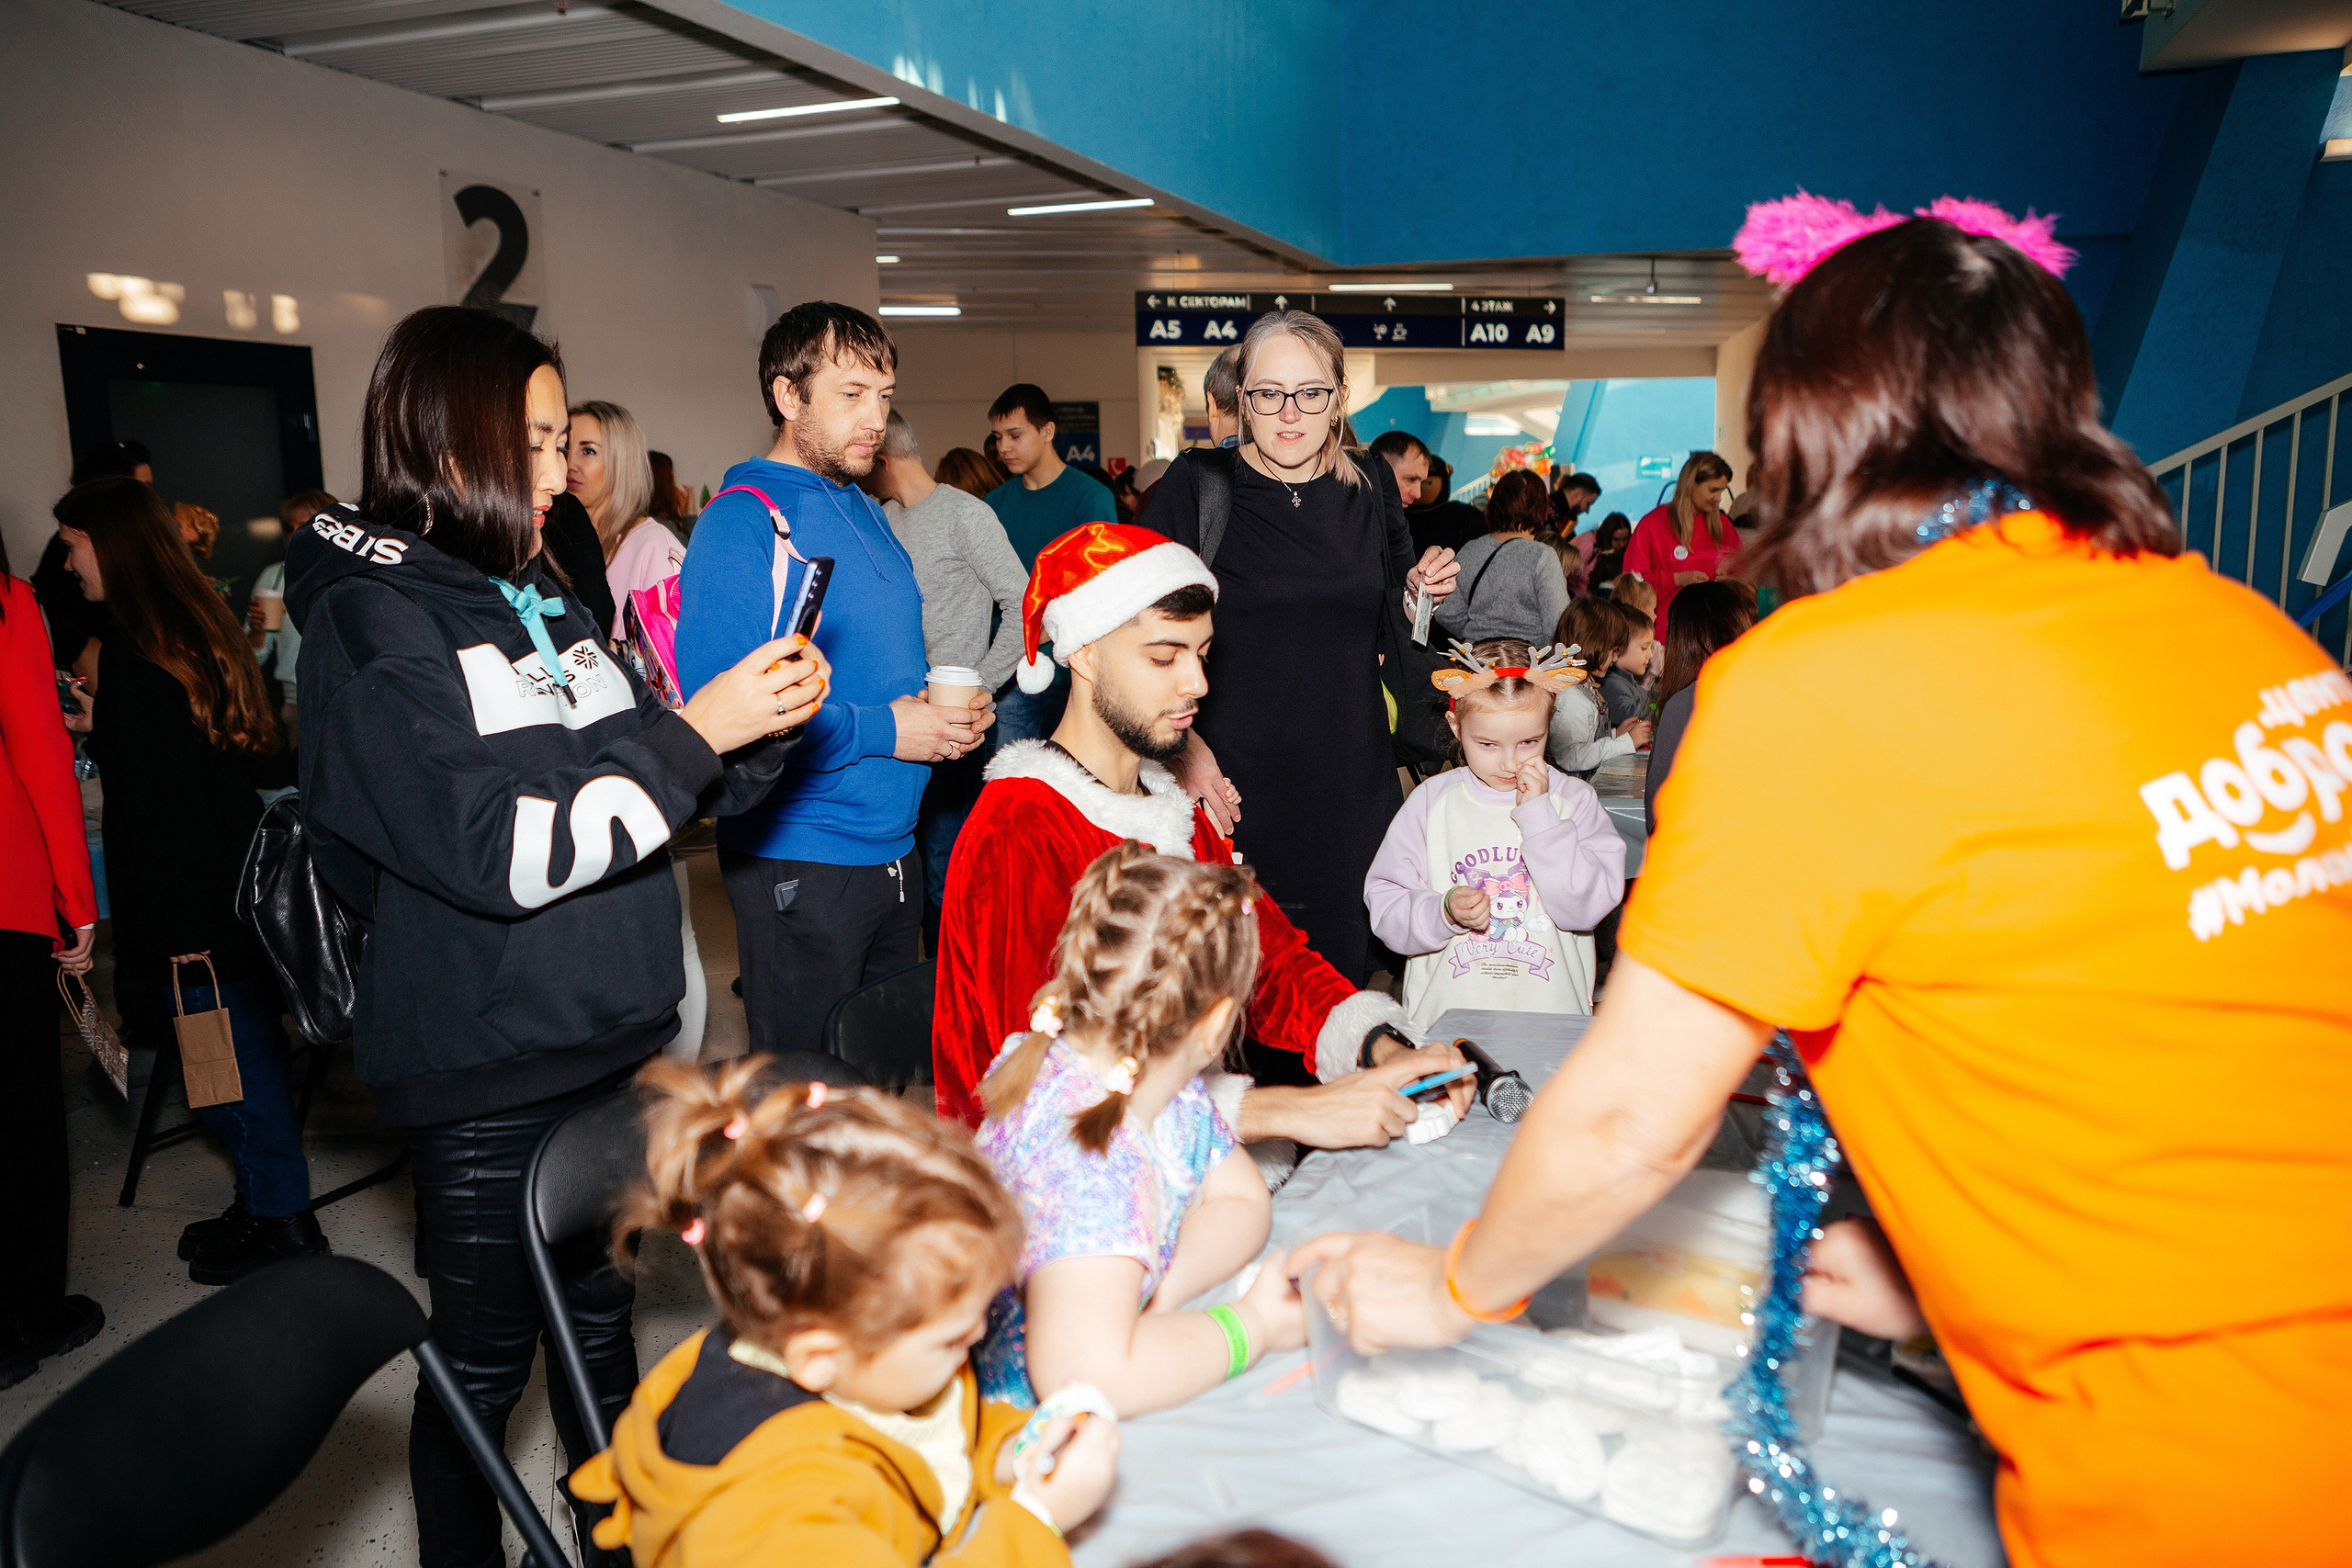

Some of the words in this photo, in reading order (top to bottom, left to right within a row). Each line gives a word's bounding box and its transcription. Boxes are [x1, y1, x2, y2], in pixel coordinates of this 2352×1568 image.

[453, 185, 539, 332] 2
[1166, 295, 1177, 309] К
[1179, 295, 1247, 309] СЕКТОРАМ
[1470, 299, 1480, 312] 4
[1481, 299, 1514, 313] ЭТАЖ
[1450, 846, 1525, 885] GOODLU
[1461, 938, 1501, 959] Very
[1507, 941, 1542, 958] Cute
